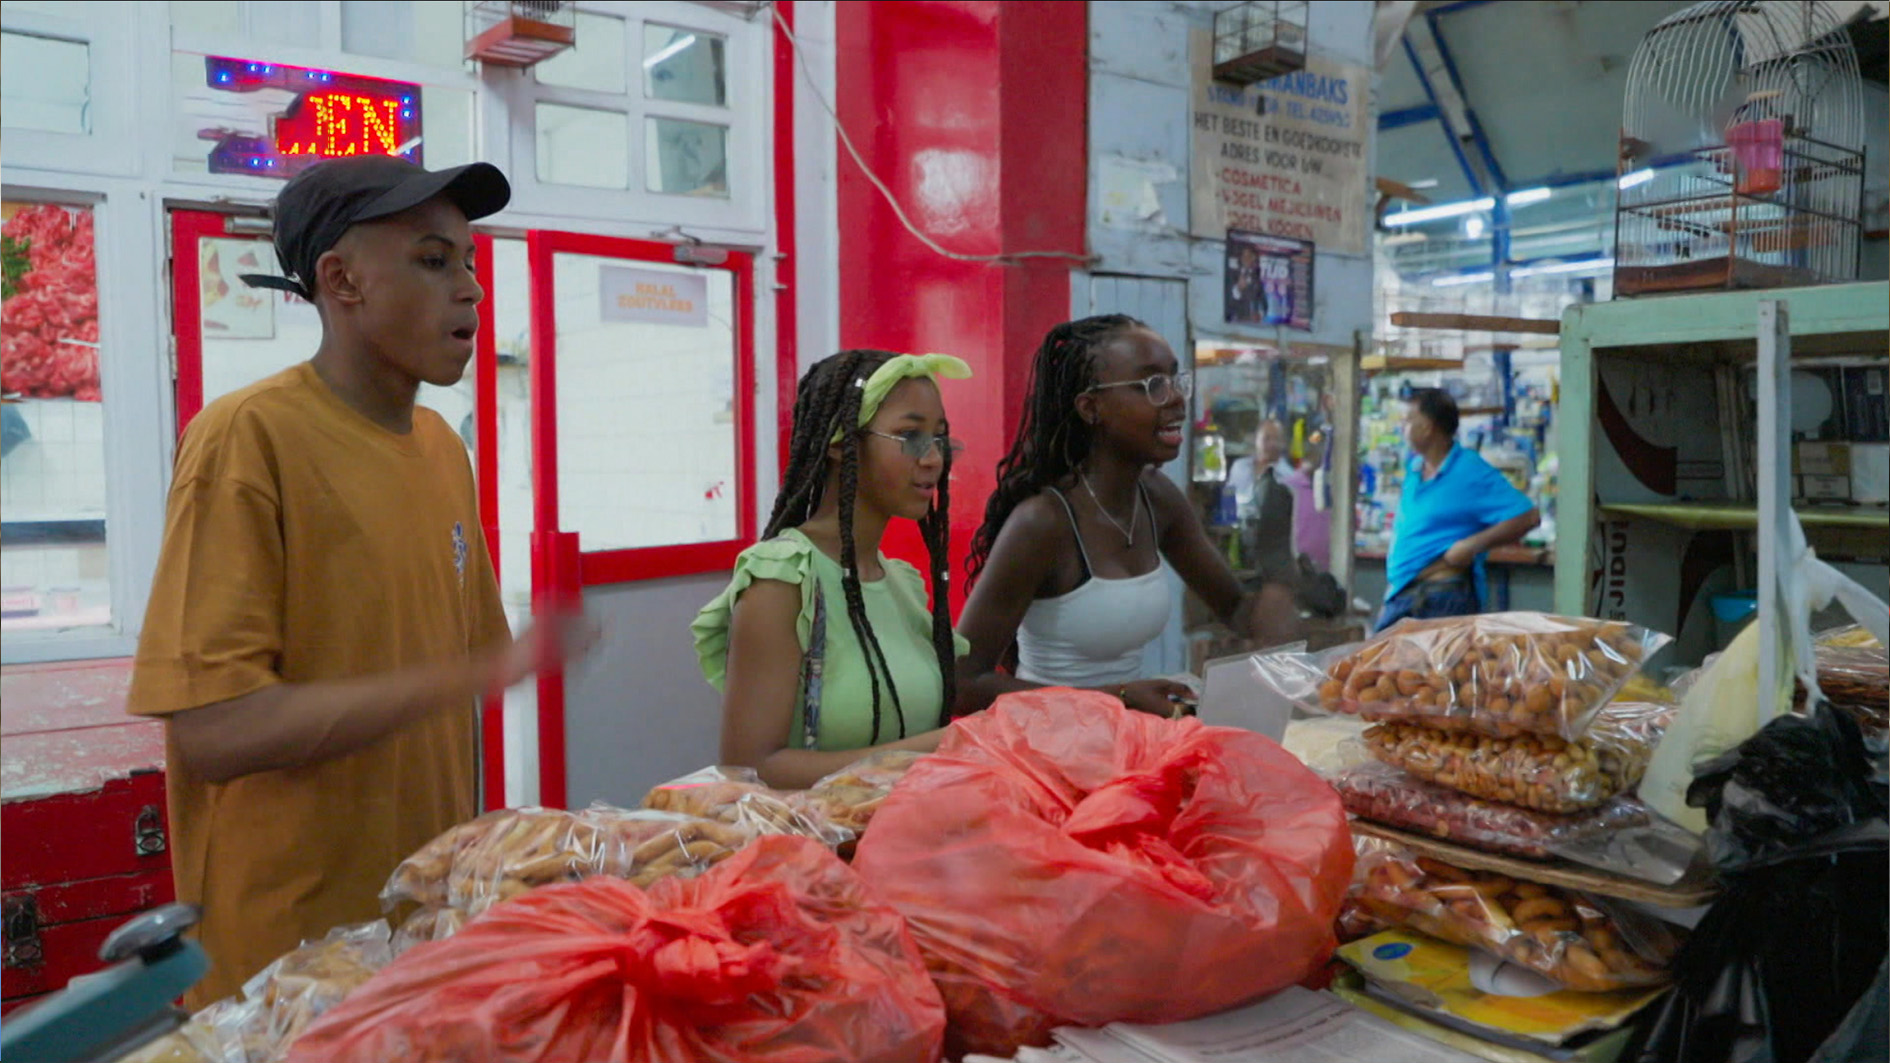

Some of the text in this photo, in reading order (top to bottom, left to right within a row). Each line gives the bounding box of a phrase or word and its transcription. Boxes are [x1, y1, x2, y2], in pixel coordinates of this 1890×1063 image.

[1194, 111, 1217, 131] HET
[1223, 117, 1259, 140] BESTE
[1264, 126, 1279, 143] EN
[1220, 143, 1259, 164] ADRES
[1266, 150, 1297, 170] VOOR
